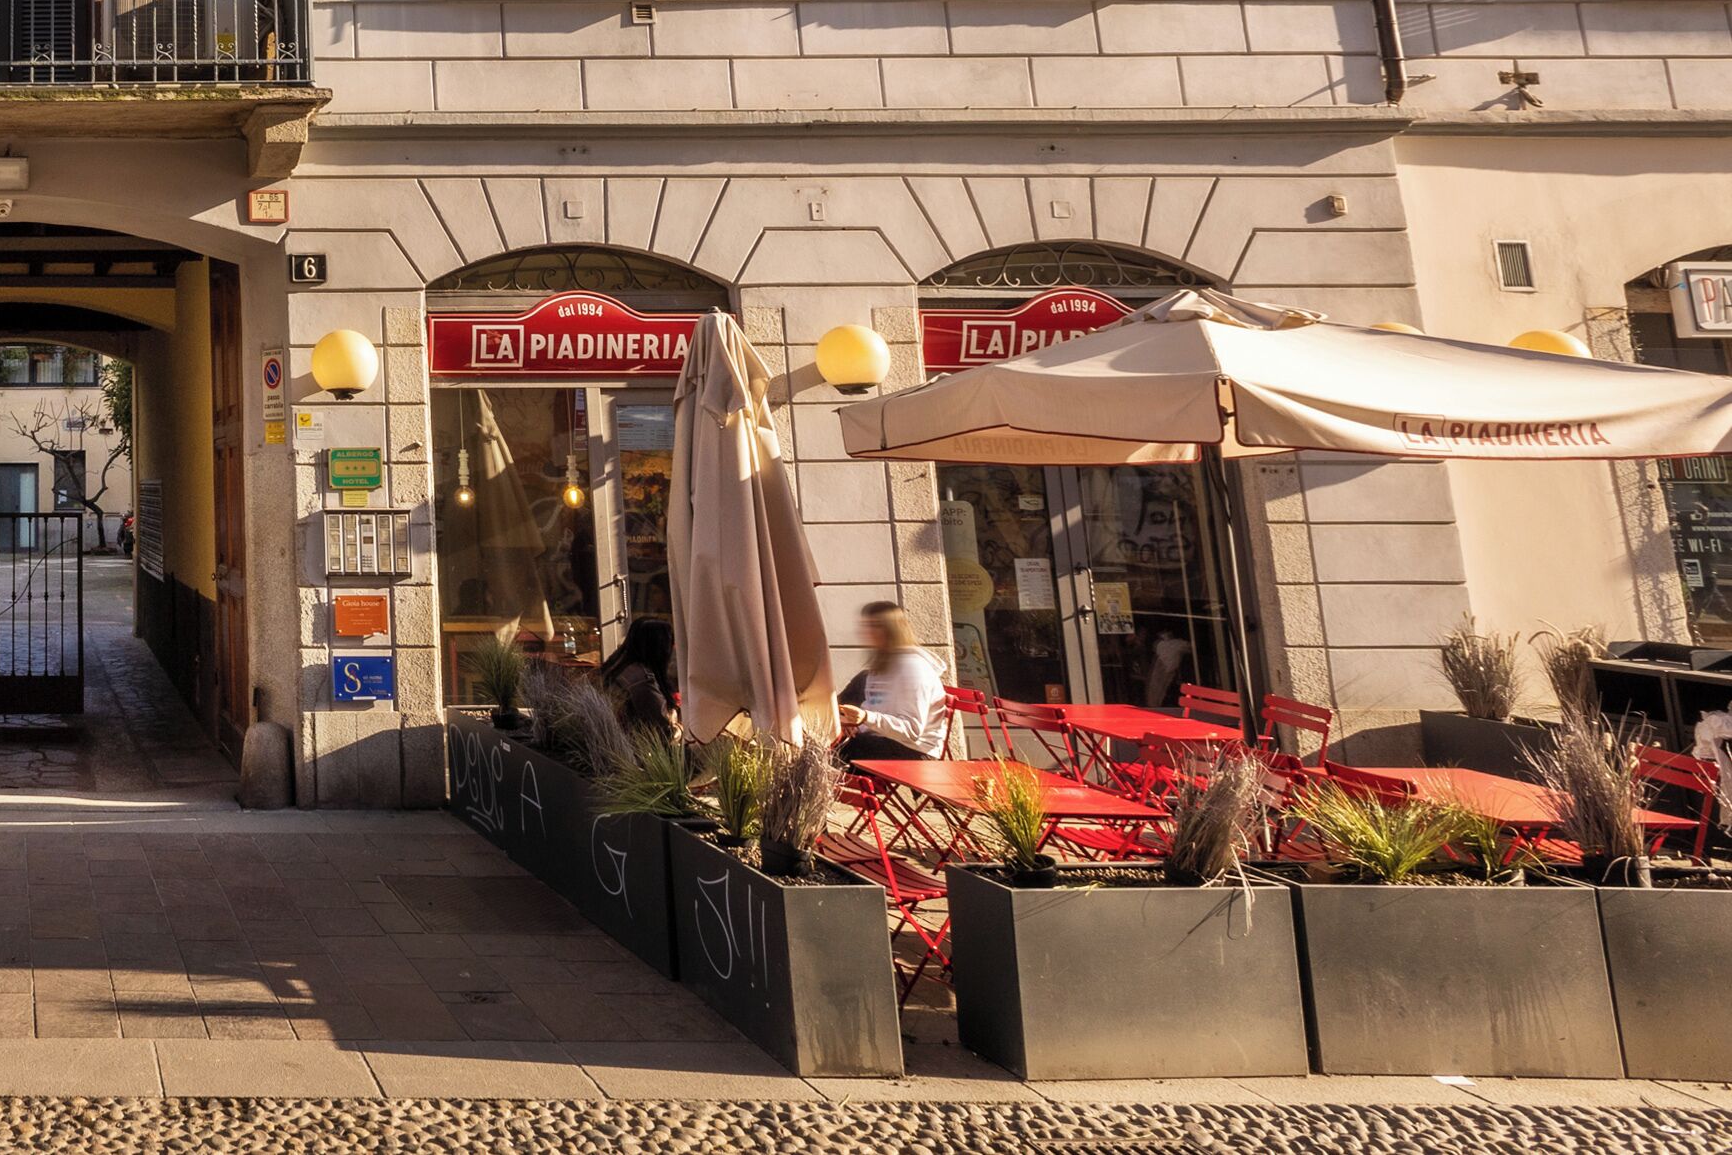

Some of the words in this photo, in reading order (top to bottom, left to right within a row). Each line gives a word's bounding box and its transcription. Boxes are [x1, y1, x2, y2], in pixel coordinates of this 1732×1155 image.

[304, 257, 317, 278] 6
[558, 305, 576, 317] dal
[578, 303, 603, 317] 1994
[1050, 300, 1067, 314] dal
[1070, 299, 1097, 314] 1994
[480, 334, 515, 359] LA
[530, 333, 688, 359] PIADINERIA
[969, 329, 1005, 355] LA
[1401, 420, 1439, 445] LA
[1449, 422, 1611, 446] PIADINERIA
[1687, 538, 1722, 553] WI-FI
